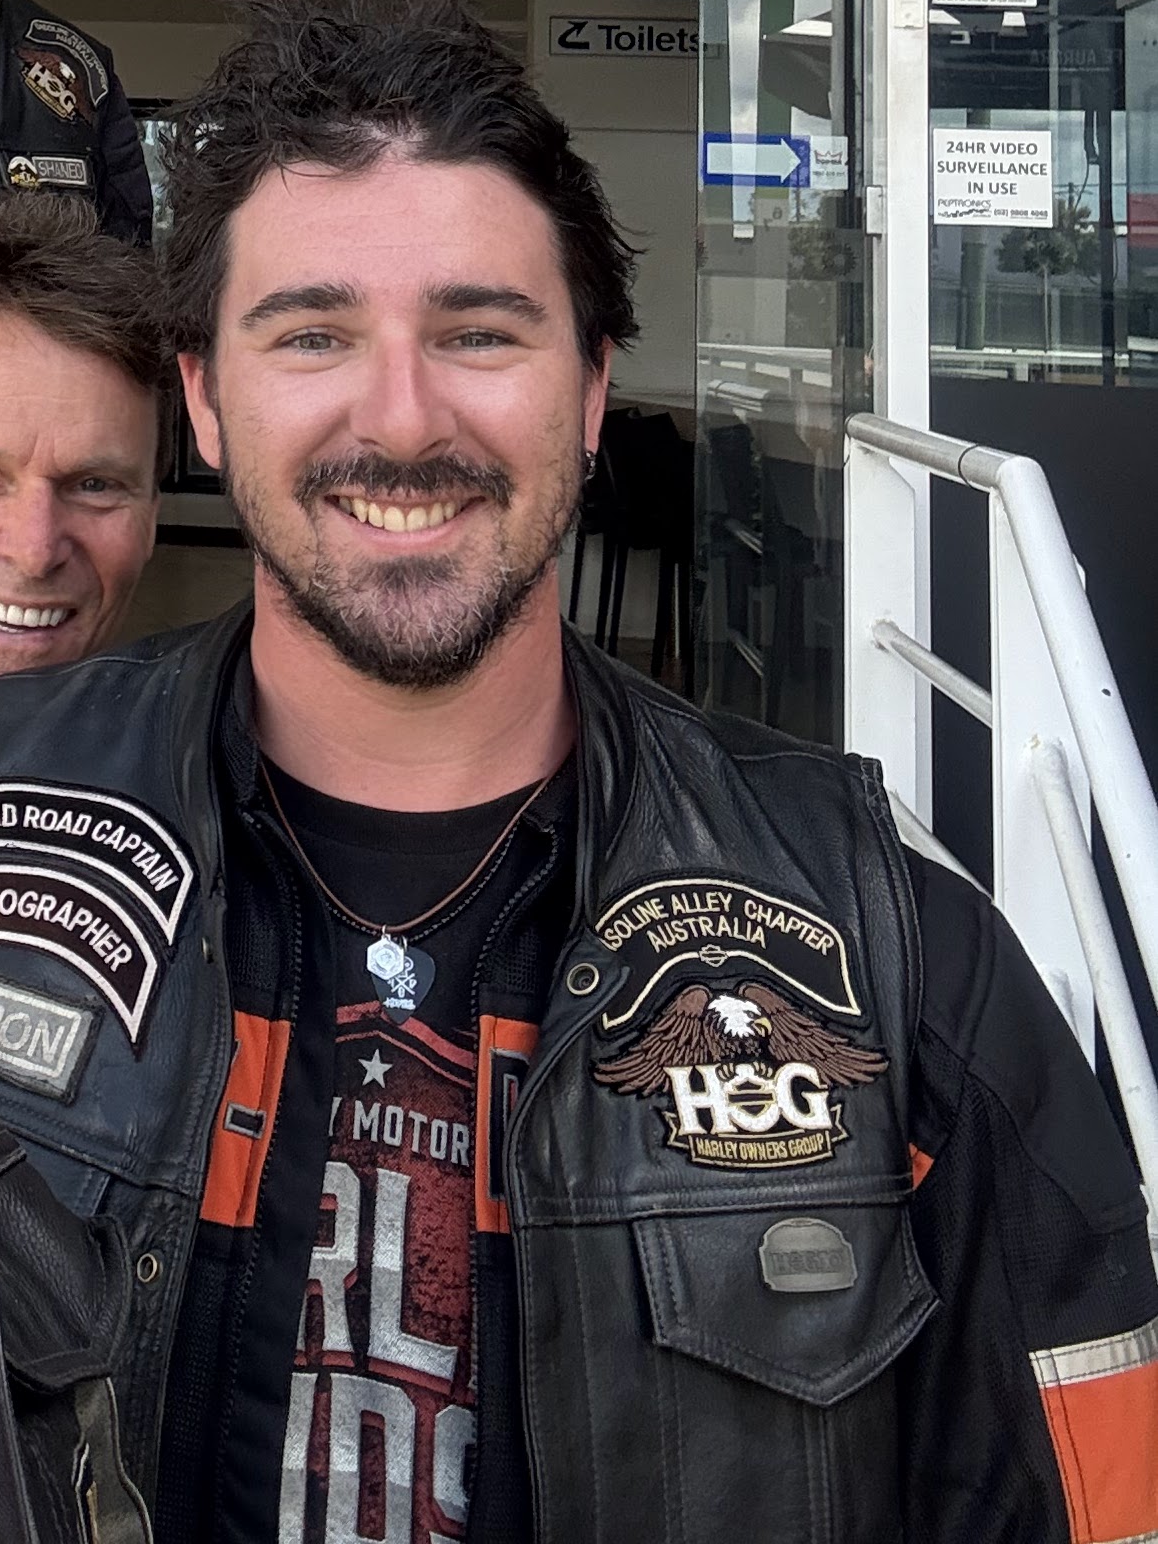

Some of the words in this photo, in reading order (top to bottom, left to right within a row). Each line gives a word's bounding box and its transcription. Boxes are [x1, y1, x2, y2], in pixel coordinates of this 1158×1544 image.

[946, 141, 986, 154] 24HR
[990, 142, 1038, 155] VIDEO
[937, 160, 1048, 176] SURVEILLANCE
[968, 181, 984, 194] IN
[989, 182, 1018, 195] USE
[23, 805, 92, 836] ROAD
[91, 819, 180, 893] CAPTAIN
[602, 898, 669, 949] SOLINE
[671, 892, 733, 914] ALLEY
[744, 899, 836, 956] CHAPTER
[646, 914, 767, 953] AUSTRALIA
[663, 1061, 834, 1136] HOG
[353, 1099, 470, 1167] MOTOR
[695, 1136, 738, 1160] HARLEY
[738, 1140, 788, 1161] OWNERS
[787, 1132, 824, 1157] GROUP
